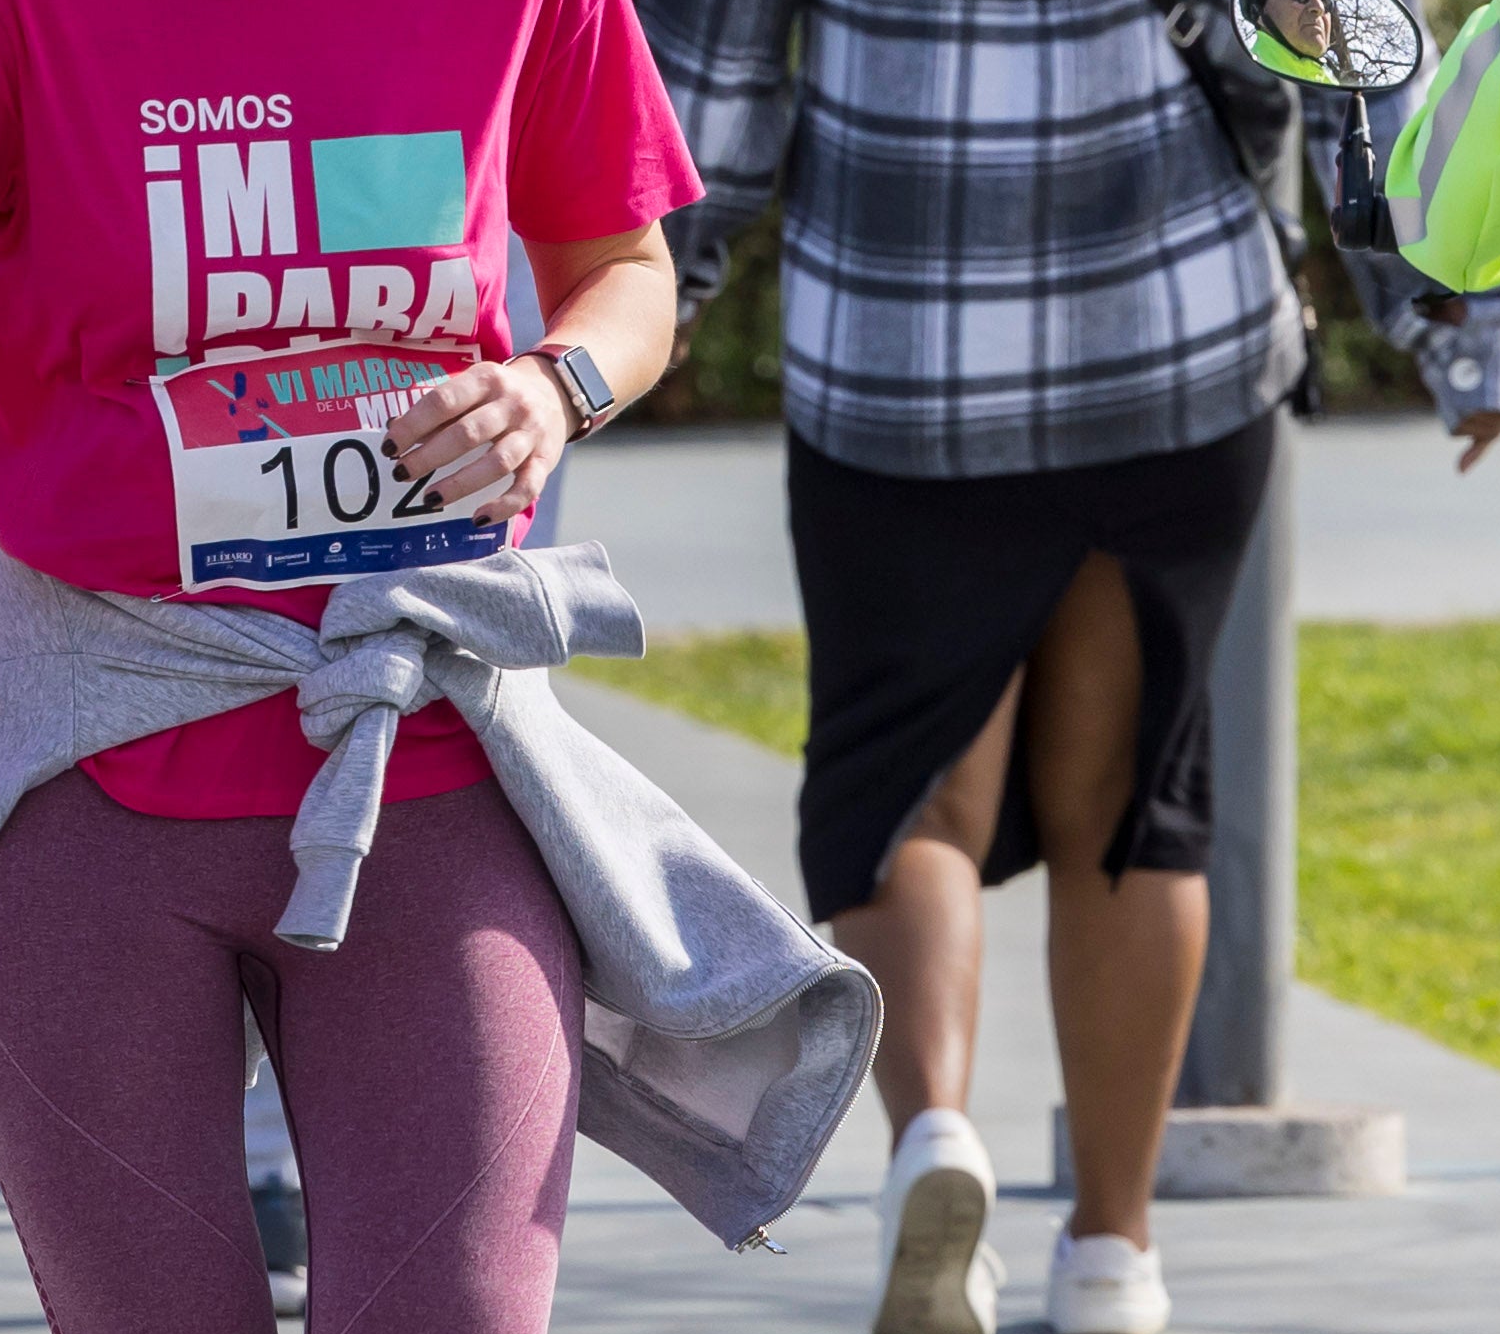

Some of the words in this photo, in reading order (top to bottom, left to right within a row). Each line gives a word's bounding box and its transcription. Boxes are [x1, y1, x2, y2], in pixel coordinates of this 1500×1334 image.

[140, 93, 293, 134] SOMOS
[266, 370, 307, 405] VI
[311, 357, 450, 399] MARCHA
[316, 402, 334, 413] DE
[336, 400, 354, 412] LA
